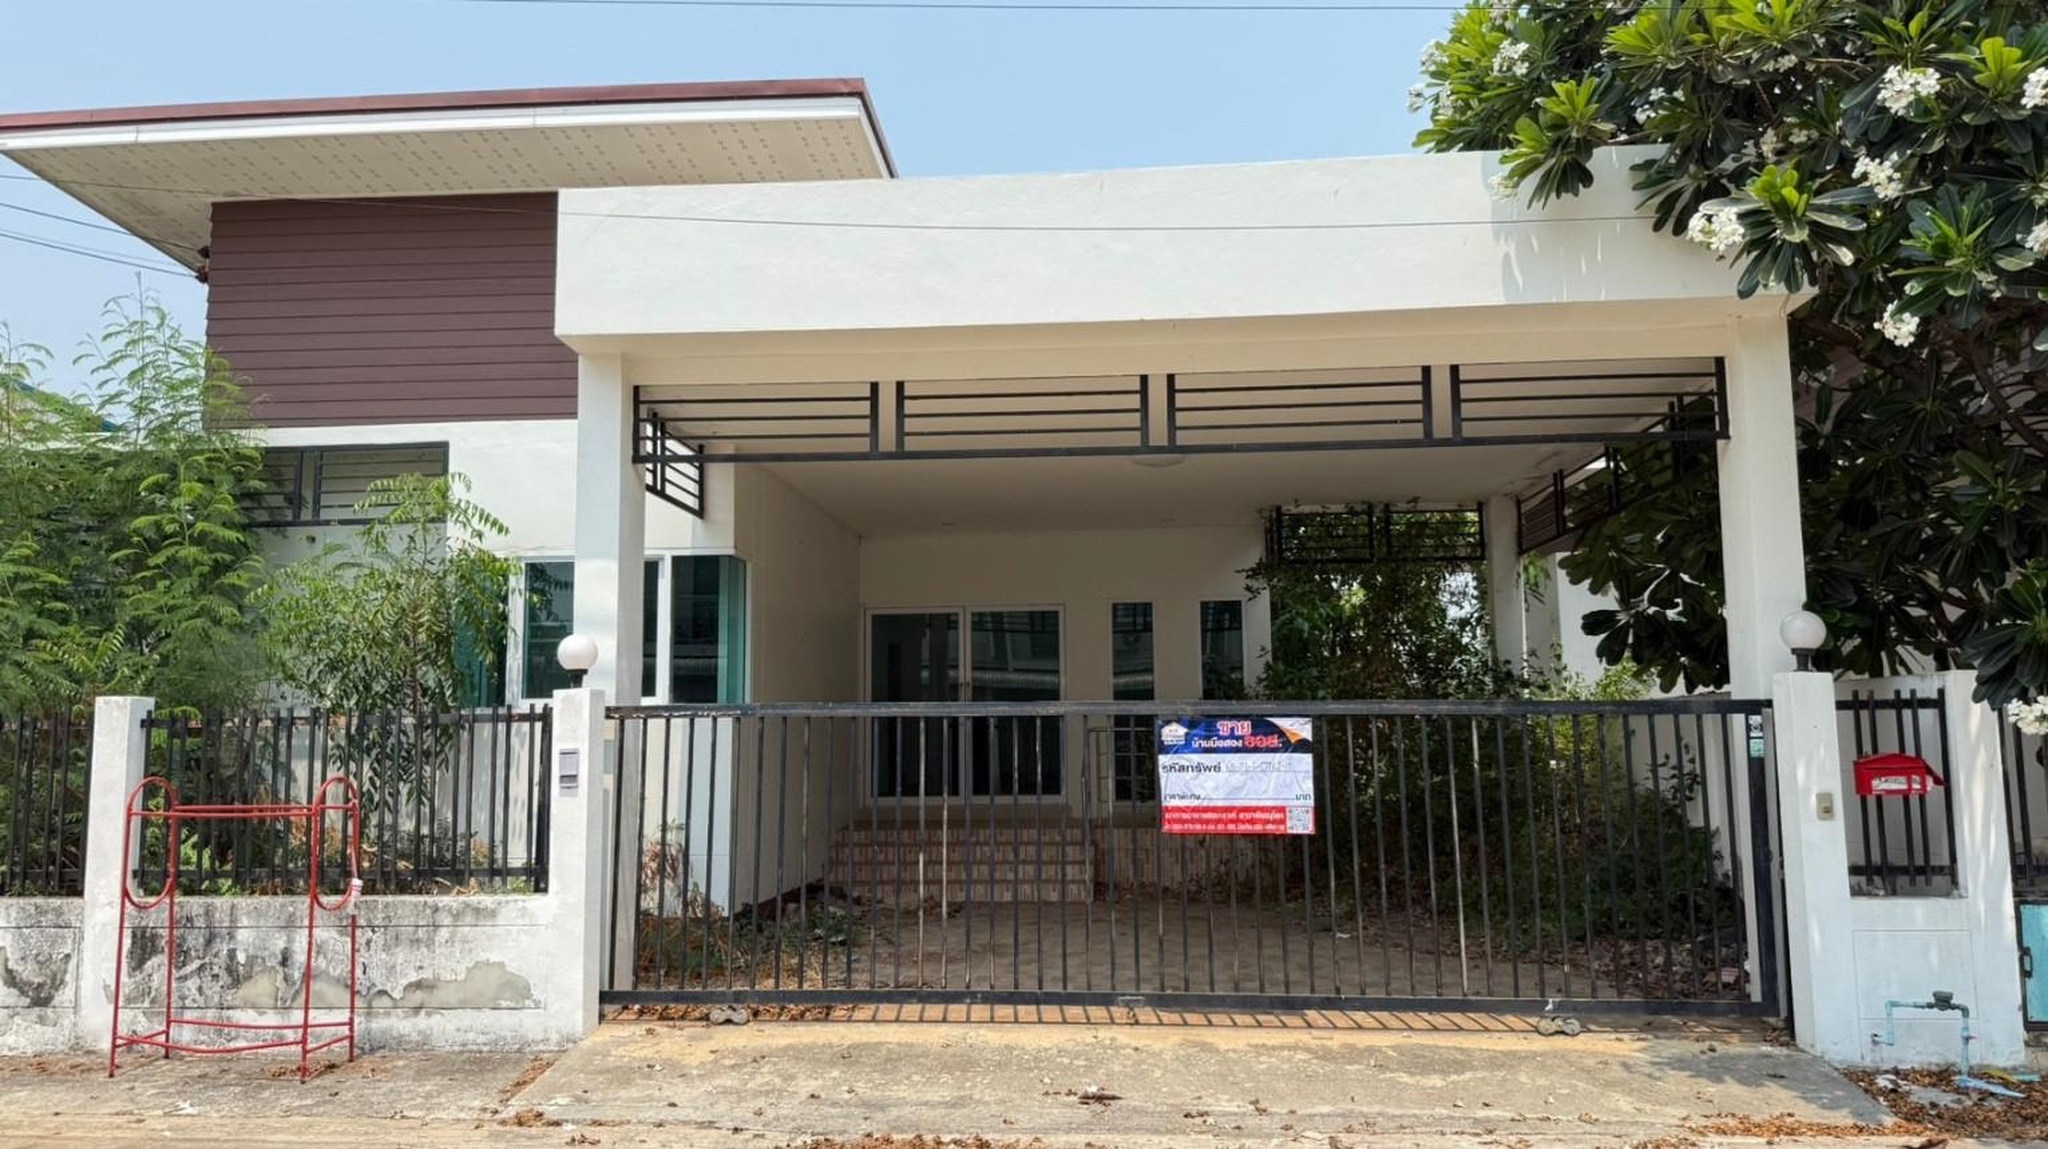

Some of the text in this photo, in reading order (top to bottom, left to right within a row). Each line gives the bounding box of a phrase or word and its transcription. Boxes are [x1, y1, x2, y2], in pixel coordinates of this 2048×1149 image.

[1217, 720, 1252, 735] ขาย
[1161, 761, 1221, 774] รหัสทรัพย์
